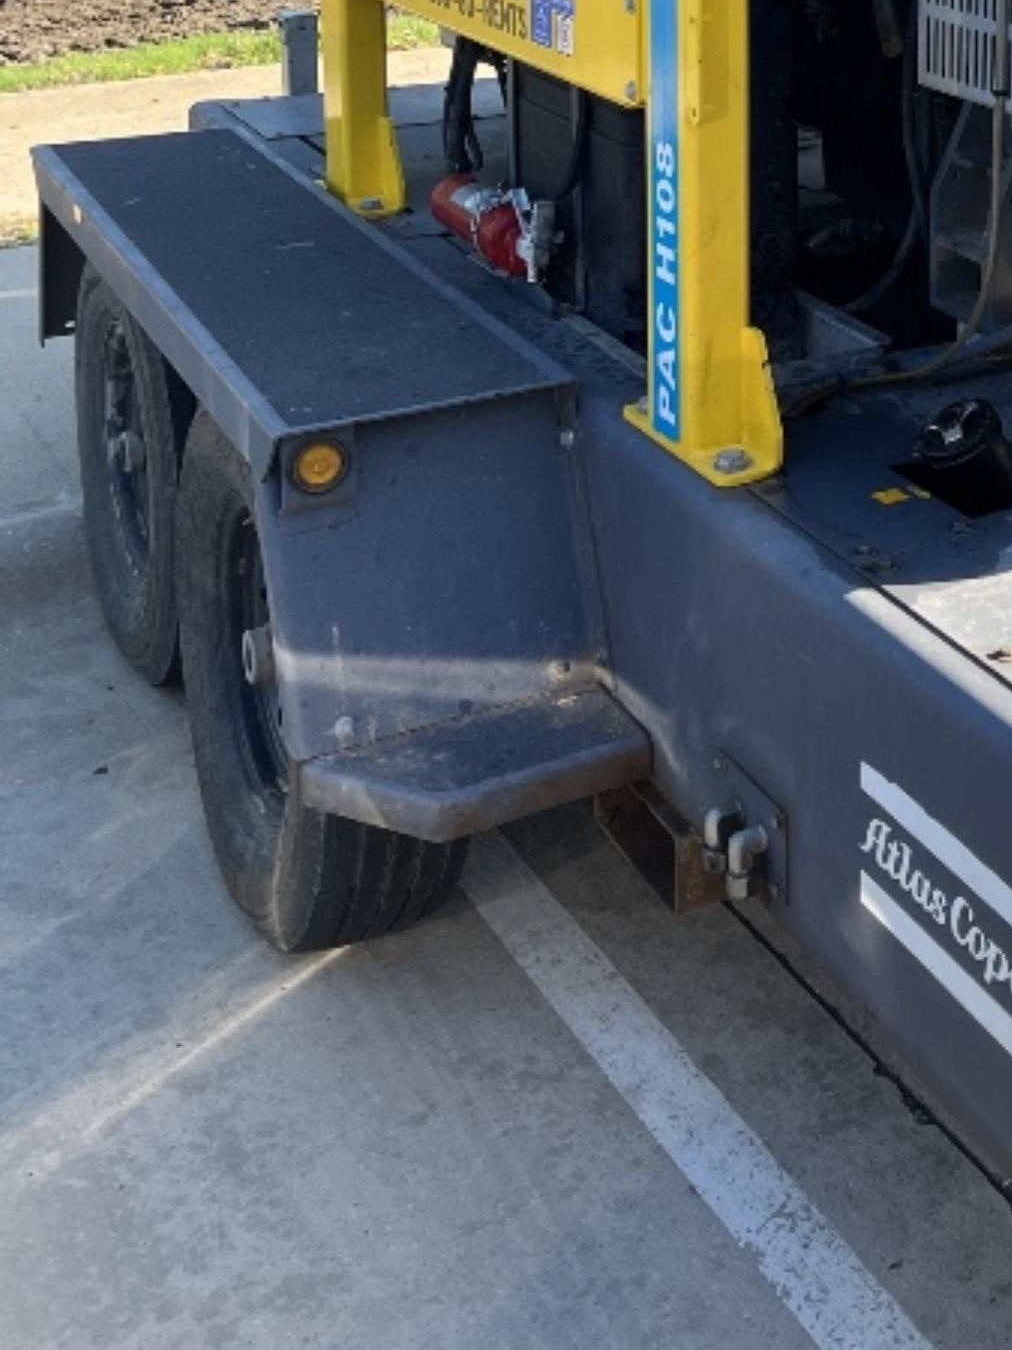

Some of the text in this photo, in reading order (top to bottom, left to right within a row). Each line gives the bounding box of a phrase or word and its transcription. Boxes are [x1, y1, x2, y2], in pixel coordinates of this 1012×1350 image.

[655, 141, 677, 428] PAC H108
[858, 817, 947, 927] Atlas
